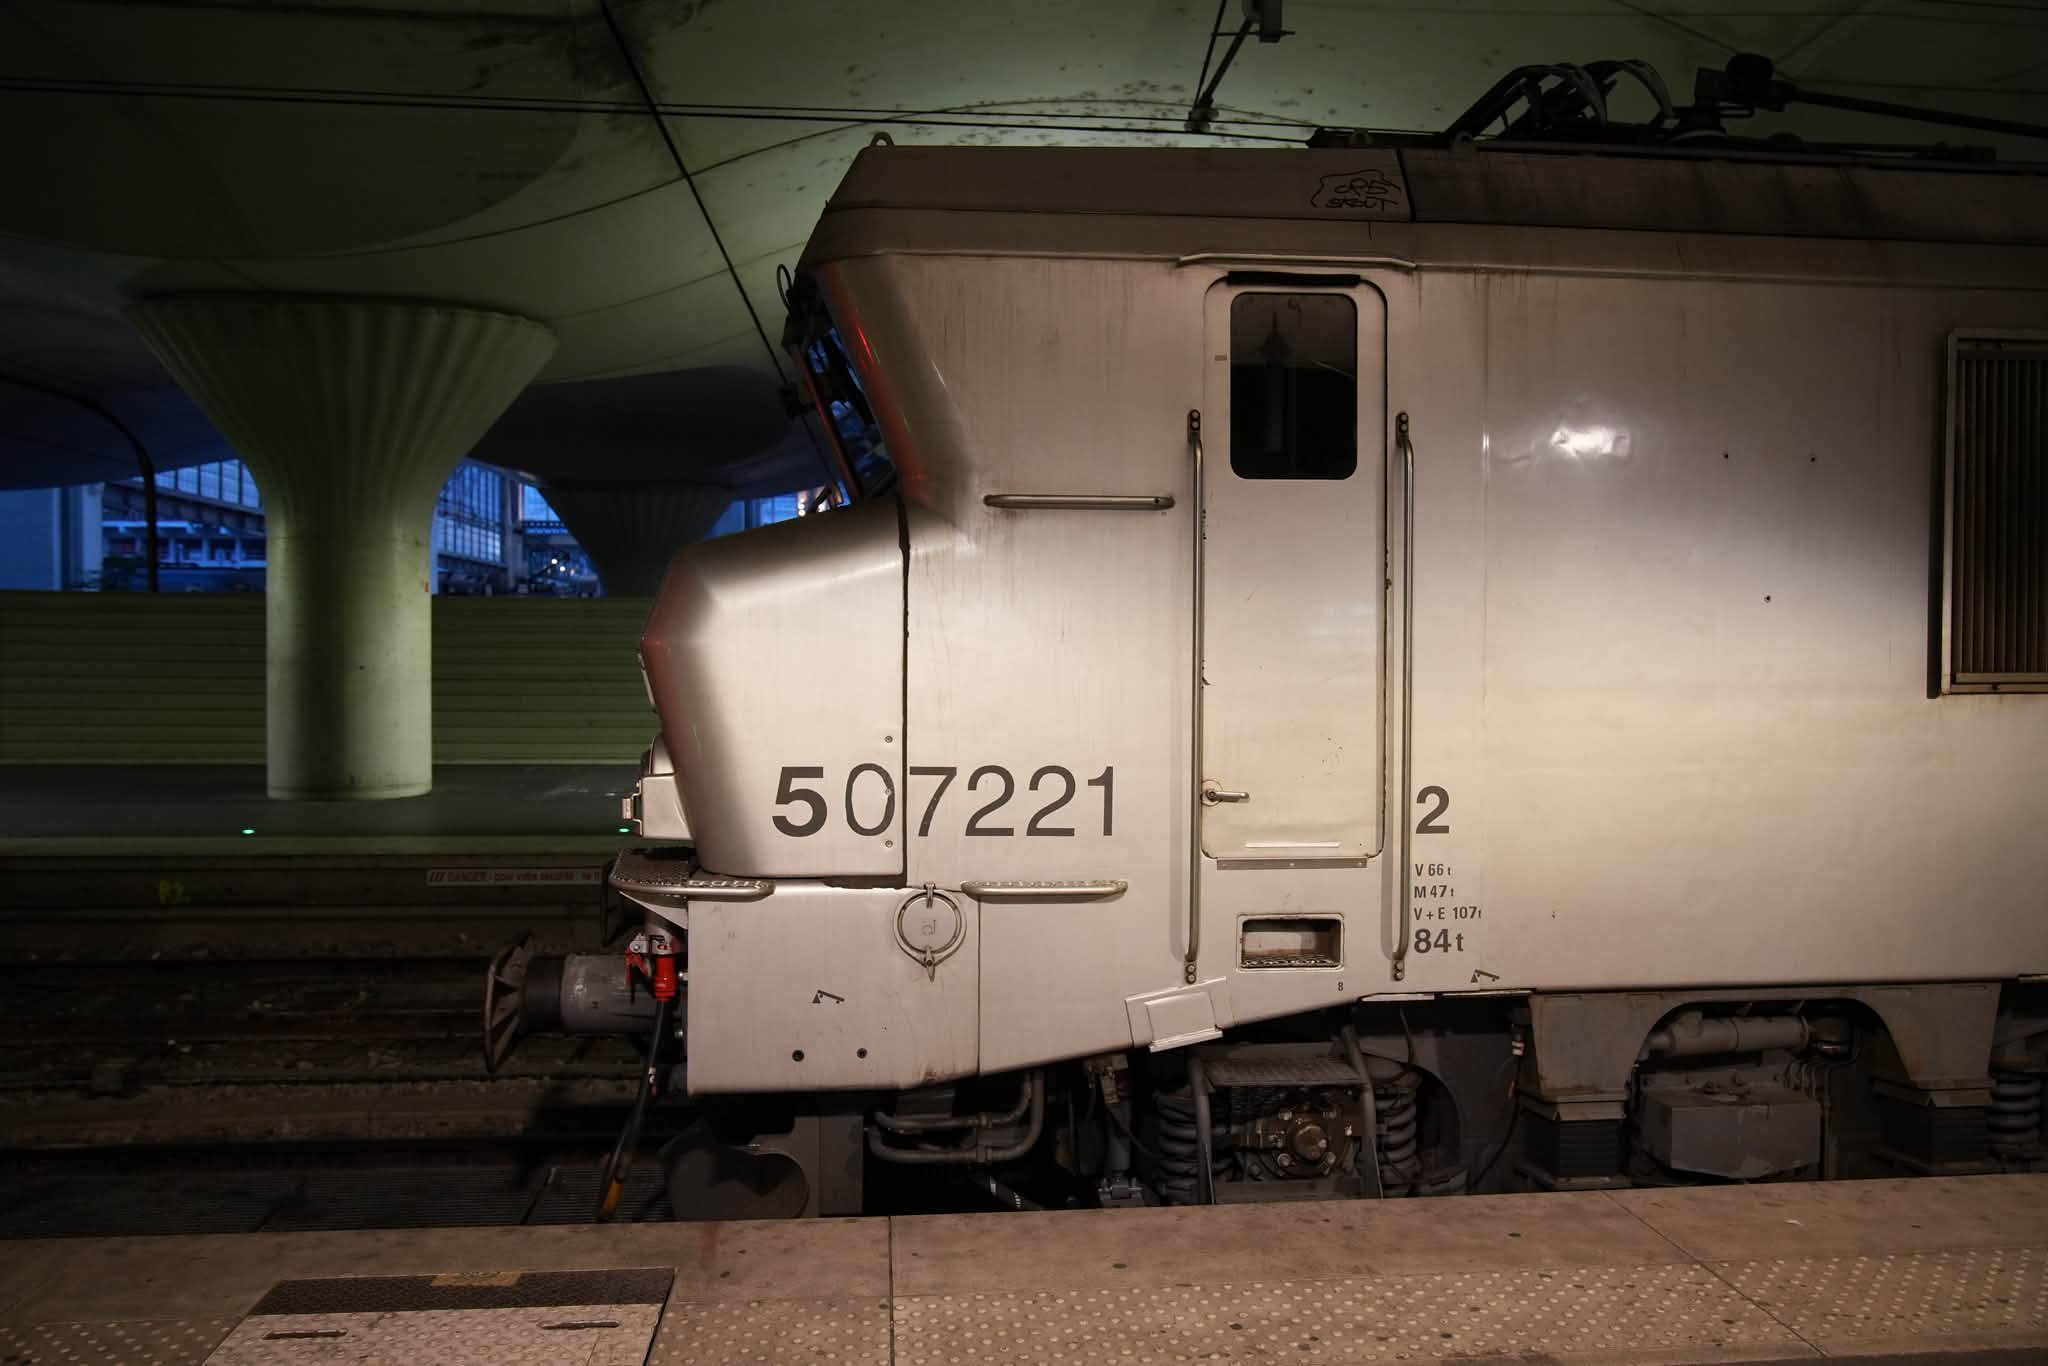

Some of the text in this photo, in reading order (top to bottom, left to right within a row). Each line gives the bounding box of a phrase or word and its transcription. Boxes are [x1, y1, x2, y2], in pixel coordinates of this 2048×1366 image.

[1416, 785, 1450, 834] 2
[1414, 863, 1424, 876] V
[1414, 885, 1426, 898] M
